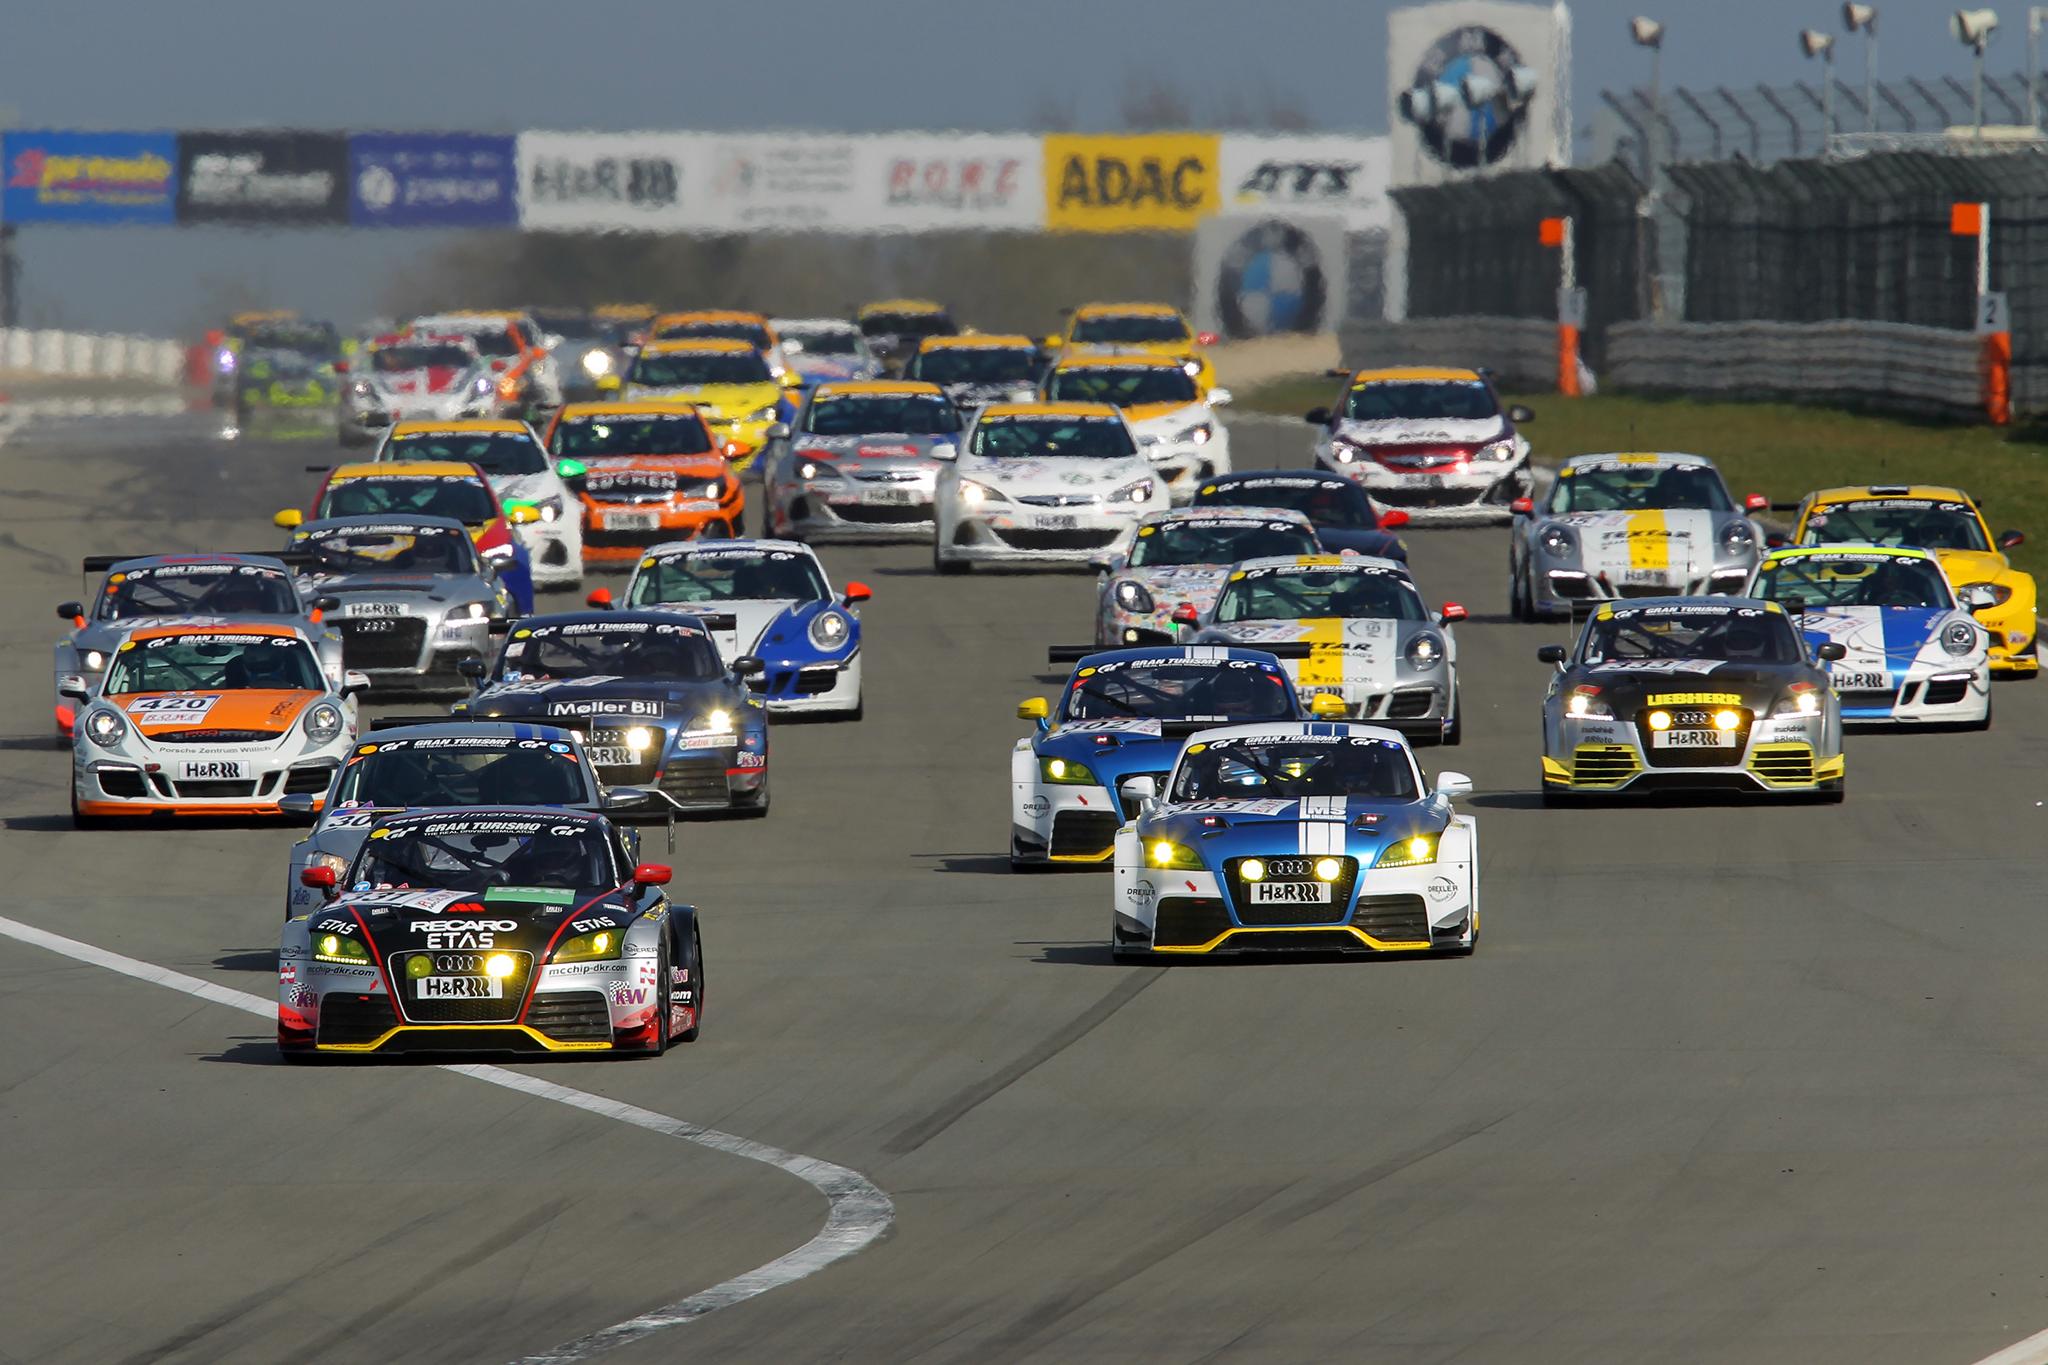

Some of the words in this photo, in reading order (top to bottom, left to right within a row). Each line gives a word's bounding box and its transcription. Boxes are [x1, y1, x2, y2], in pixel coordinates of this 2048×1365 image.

[1056, 154, 1205, 211] ADAC
[1985, 299, 1997, 325] 2
[179, 635, 210, 643] GRAN
[1168, 658, 1222, 666] TURISMO
[1834, 674, 1865, 687] H&R
[141, 699, 206, 710] 420
[1647, 693, 1742, 706] LIEBHERR
[554, 702, 627, 716] Møller
[631, 702, 657, 715] Bil
[455, 739, 513, 747] TURISMO
[1669, 731, 1702, 744] H&R
[160, 746, 196, 754] Porsche
[199, 746, 238, 754] Zentrum
[187, 762, 220, 777] H&R
[424, 822, 471, 833] GRAN
[473, 822, 541, 831] TURISMO
[1259, 885, 1297, 901] H&R
[317, 919, 359, 935] ETAS
[410, 920, 518, 933] RECARO
[571, 916, 616, 933] ETAS
[426, 932, 494, 949] ETAS
[548, 964, 628, 976] mcchip-dkr.com
[426, 977, 466, 996] H&R
[614, 988, 648, 1007] KW
